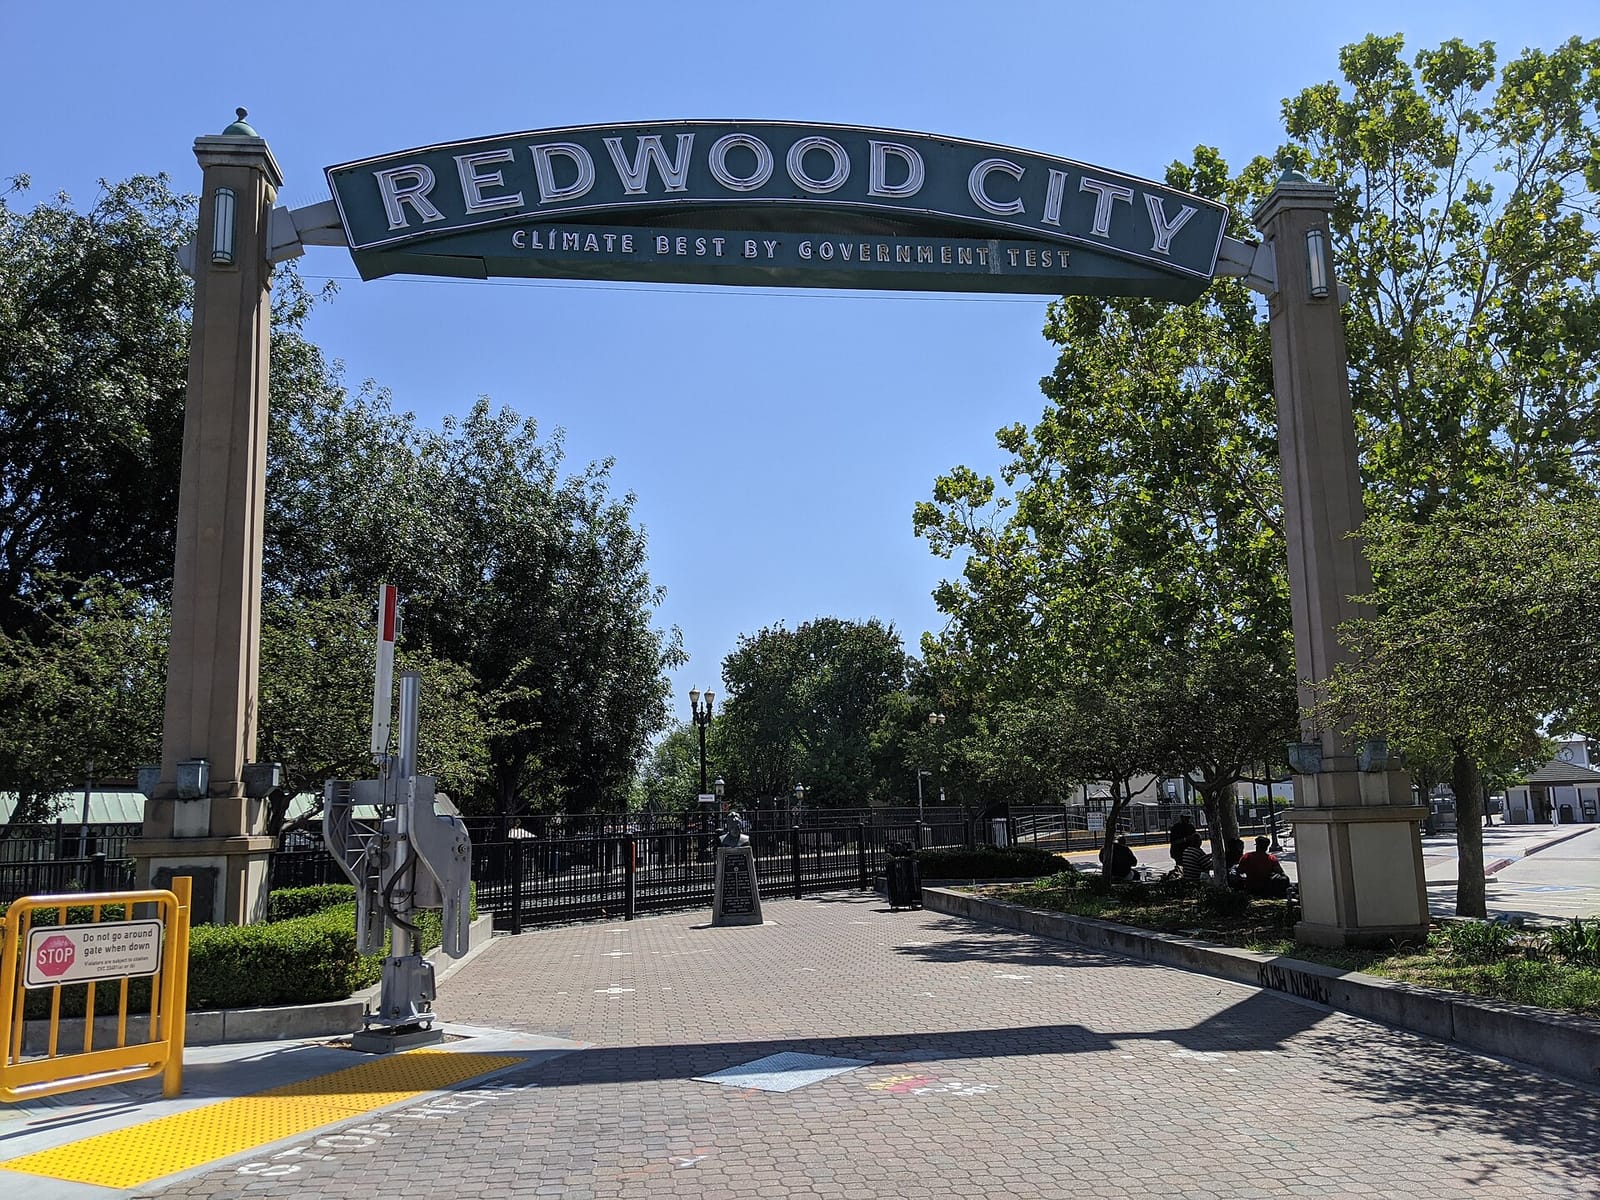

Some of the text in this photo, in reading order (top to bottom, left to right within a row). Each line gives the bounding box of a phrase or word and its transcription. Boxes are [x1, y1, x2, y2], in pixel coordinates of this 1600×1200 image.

[373, 132, 1199, 255] REDWOOD CITY
[511, 229, 1071, 268] CLIMATE BEST BY GOVERNMENT TEST
[83, 928, 153, 943] Do not go around
[83, 941, 150, 957] gate when down
[38, 947, 73, 965] STOP
[235, 1122, 401, 1177] STOP
